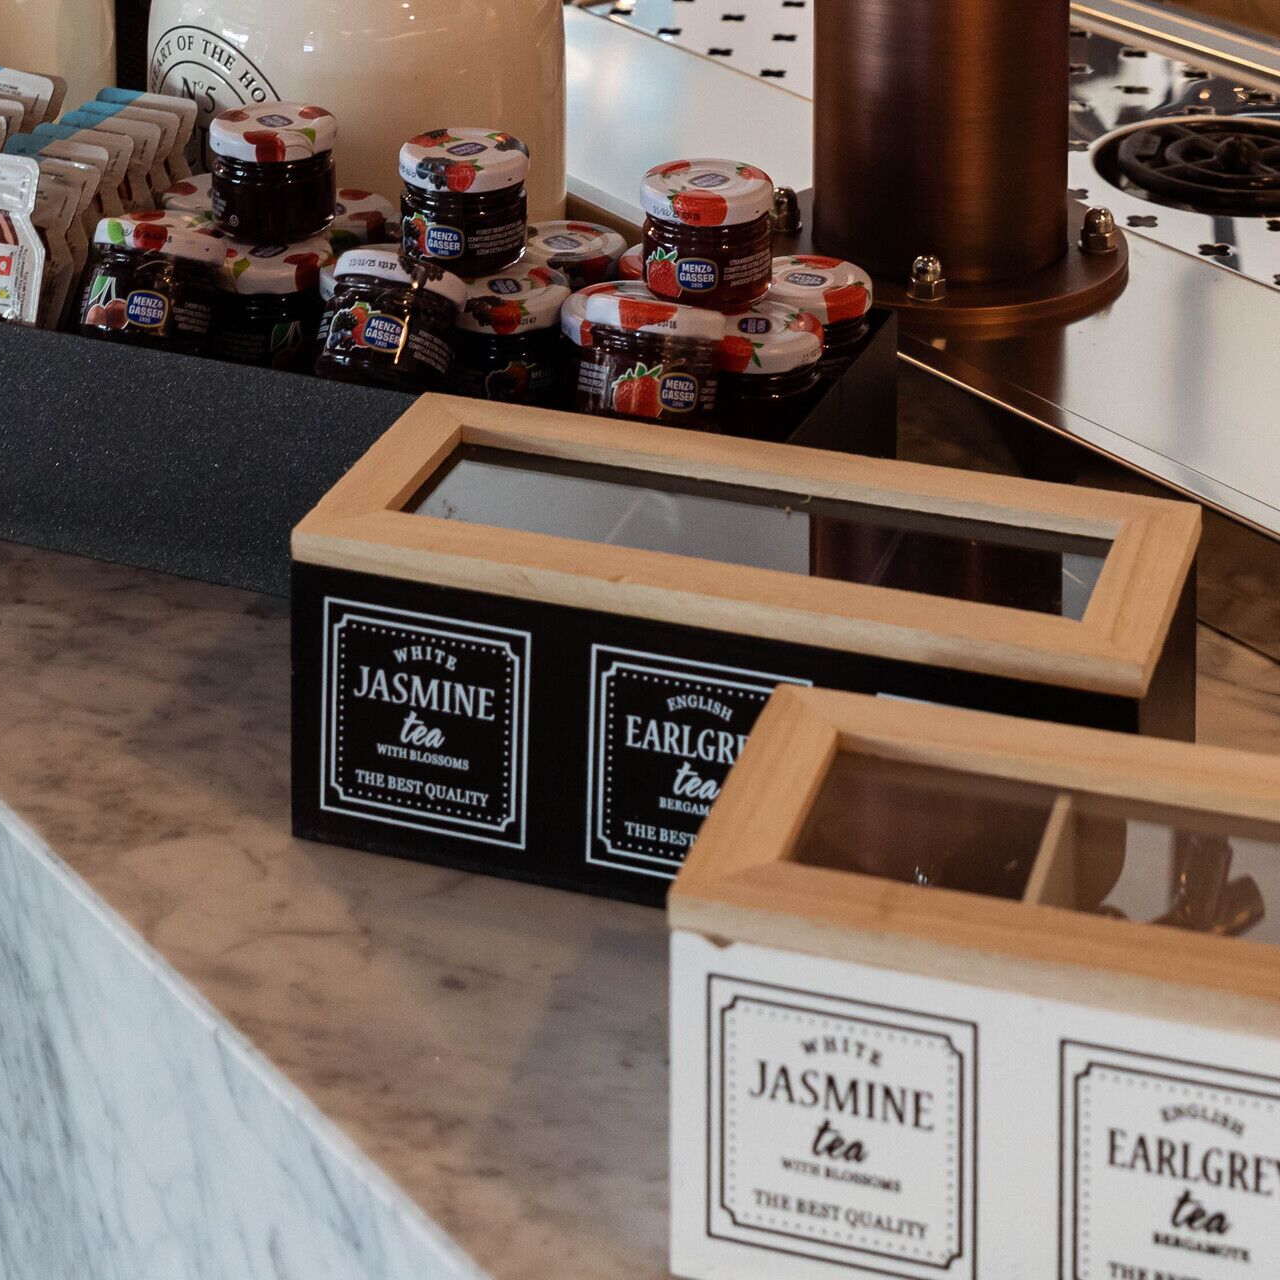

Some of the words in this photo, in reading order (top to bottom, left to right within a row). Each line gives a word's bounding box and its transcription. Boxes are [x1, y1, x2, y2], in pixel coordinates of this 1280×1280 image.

[177, 35, 195, 51] OF
[202, 39, 236, 71] THE
[238, 70, 267, 103] HO
[428, 239, 461, 250] GASSER
[680, 272, 714, 282] GASSER
[128, 304, 163, 320] GASSER
[365, 328, 400, 346] GASSER
[661, 389, 695, 402] GASSER
[393, 645, 458, 671] WHITE
[353, 665, 496, 721] JASMINE
[666, 694, 734, 722] ENGLISH
[400, 710, 446, 749] tea
[625, 715, 749, 765] EARLGR
[376, 743, 407, 760] WITH
[409, 750, 470, 771] BLOSSOMS
[355, 769, 386, 788] THE
[387, 775, 423, 795] BEST
[425, 783, 489, 808] QUALITY
[672, 761, 721, 800] tea
[658, 797, 710, 817] BERGAM
[624, 821, 657, 841] THE
[659, 827, 698, 848] BEST
[801, 1036, 882, 1067] WHITE
[749, 1059, 934, 1132] JASMINE
[1160, 1103, 1246, 1138] ENGLISH
[811, 1118, 868, 1163] tea
[782, 1155, 821, 1176] WITH
[824, 1167, 903, 1194] BLOSSOMS
[753, 1188, 791, 1211] THE
[795, 1197, 842, 1222] BEST
[844, 1209, 928, 1240] QUALITY
[1171, 1188, 1233, 1235] tea
